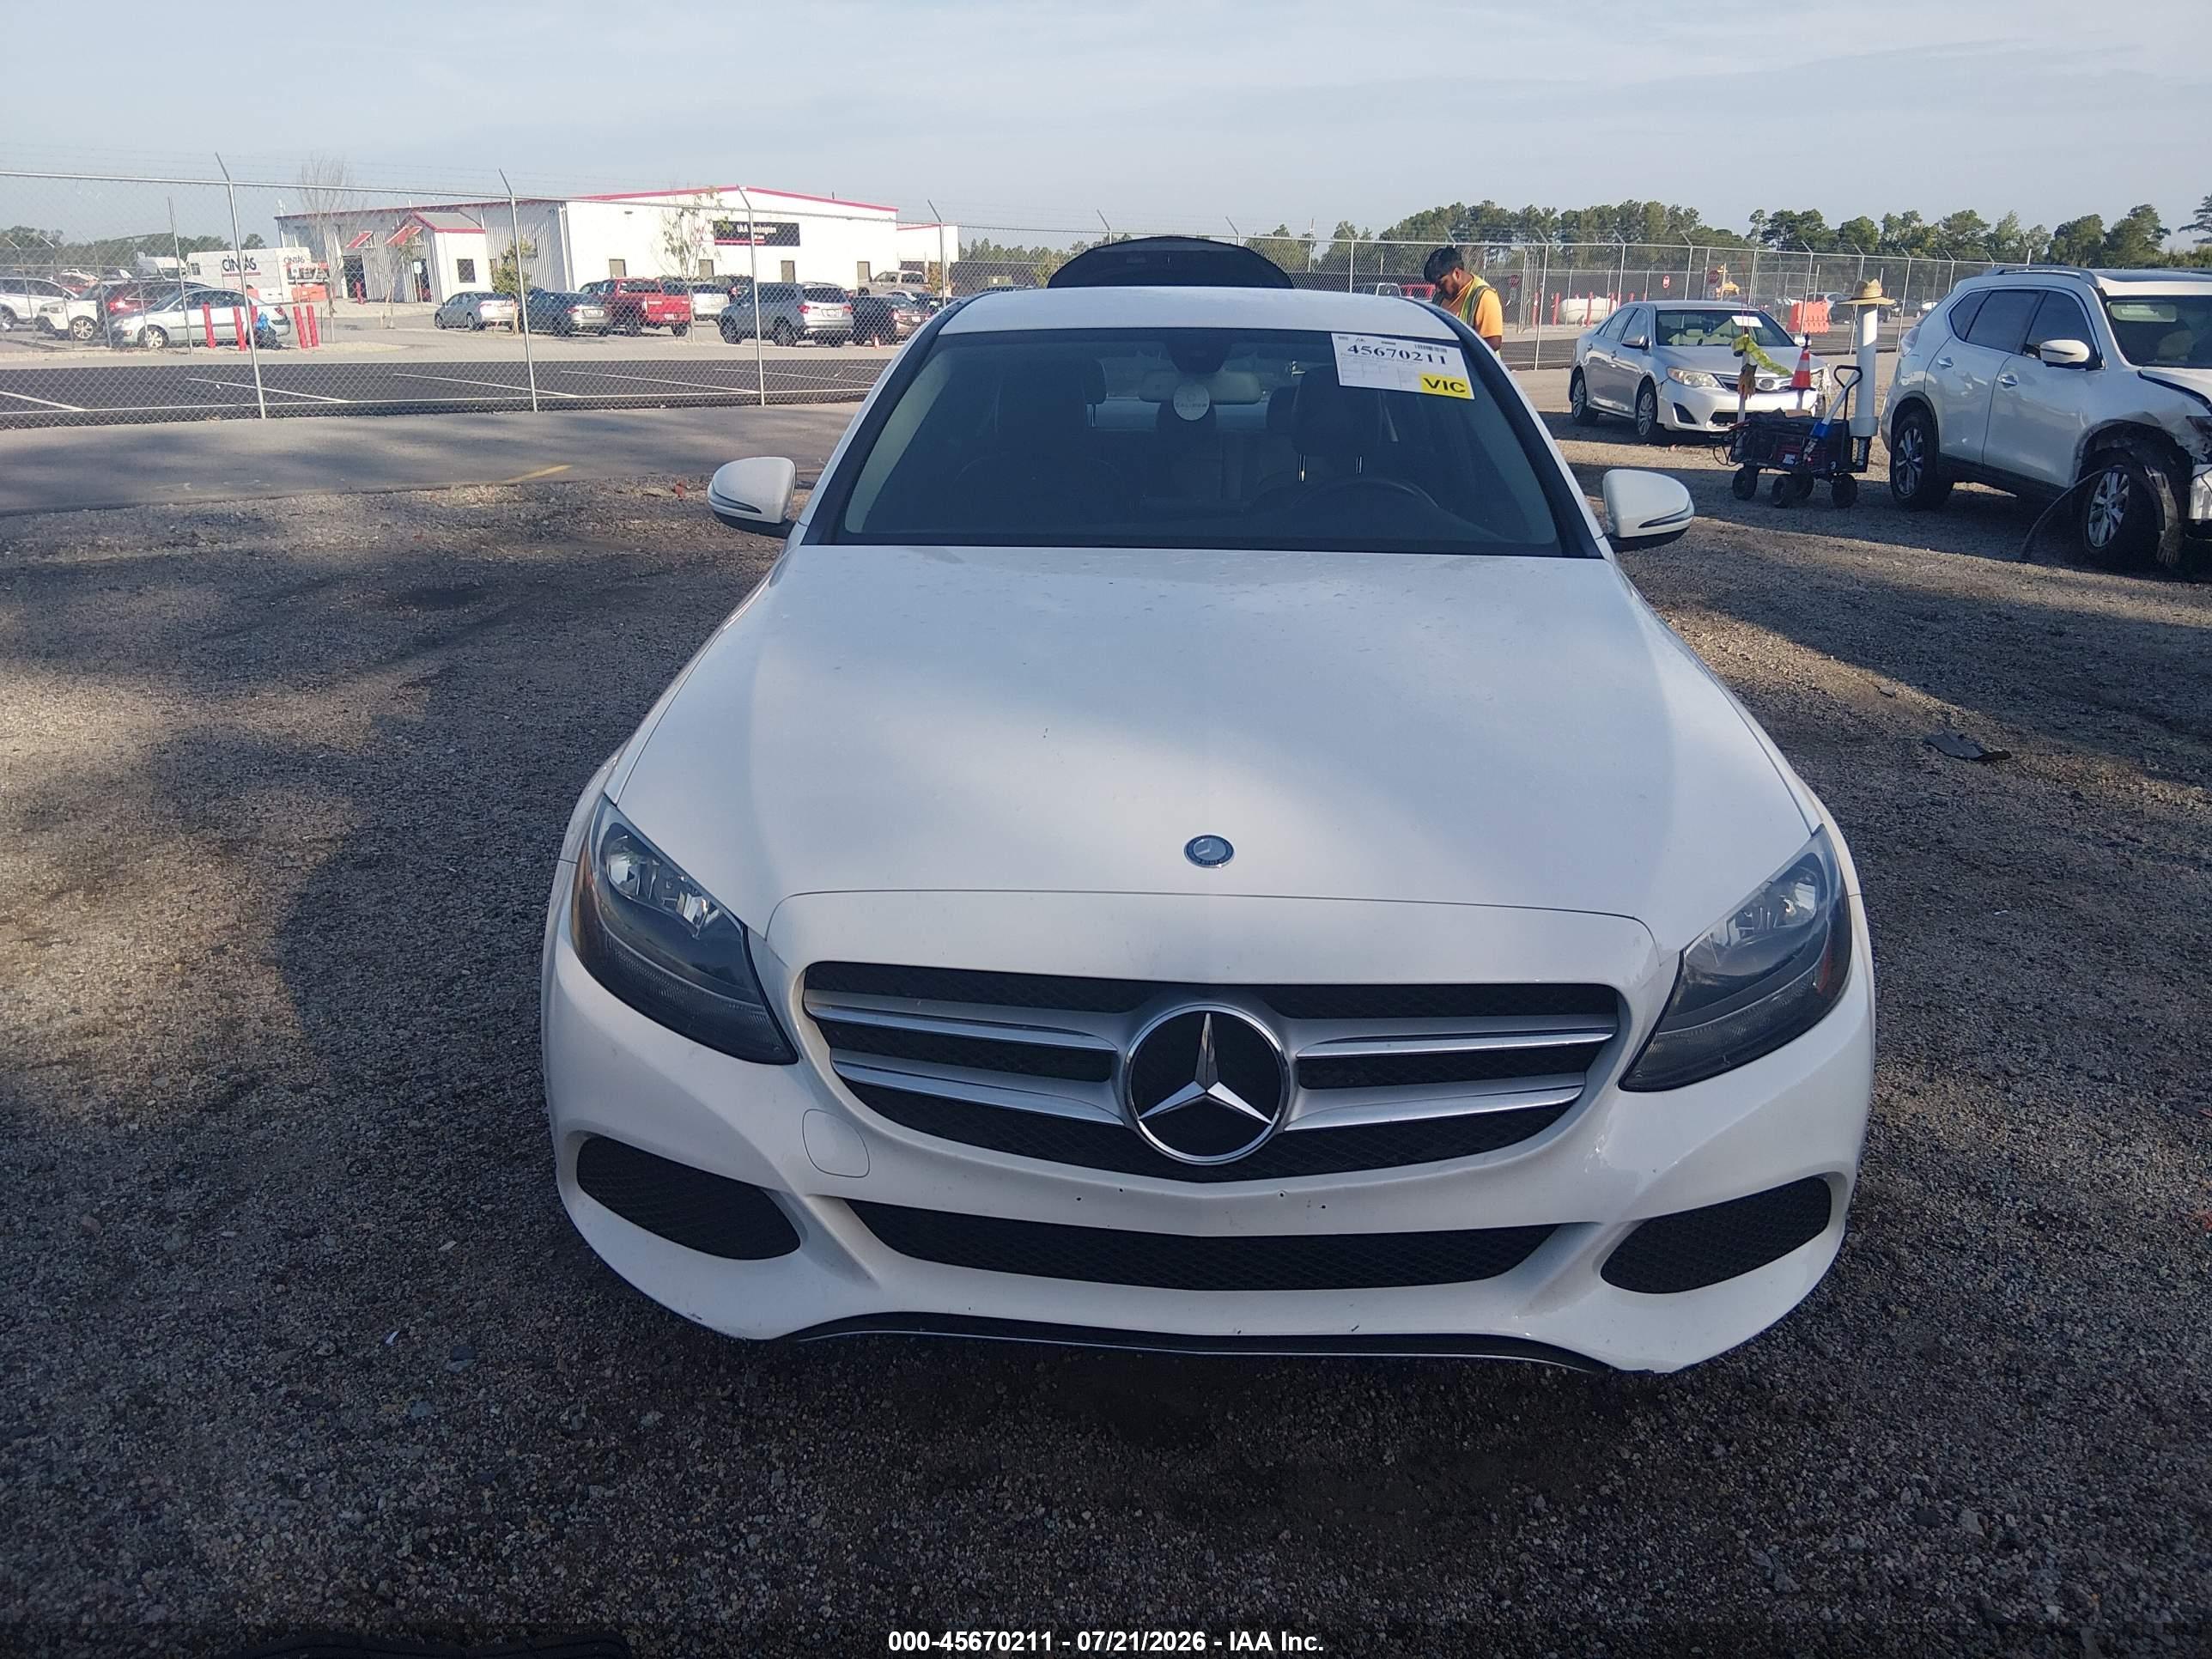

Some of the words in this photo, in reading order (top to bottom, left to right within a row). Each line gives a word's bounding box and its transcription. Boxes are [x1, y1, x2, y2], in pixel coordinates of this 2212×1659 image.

[222, 254, 258, 271] CINAS
[1347, 344, 1447, 365] 45670211
[1423, 377, 1466, 393] VIC
